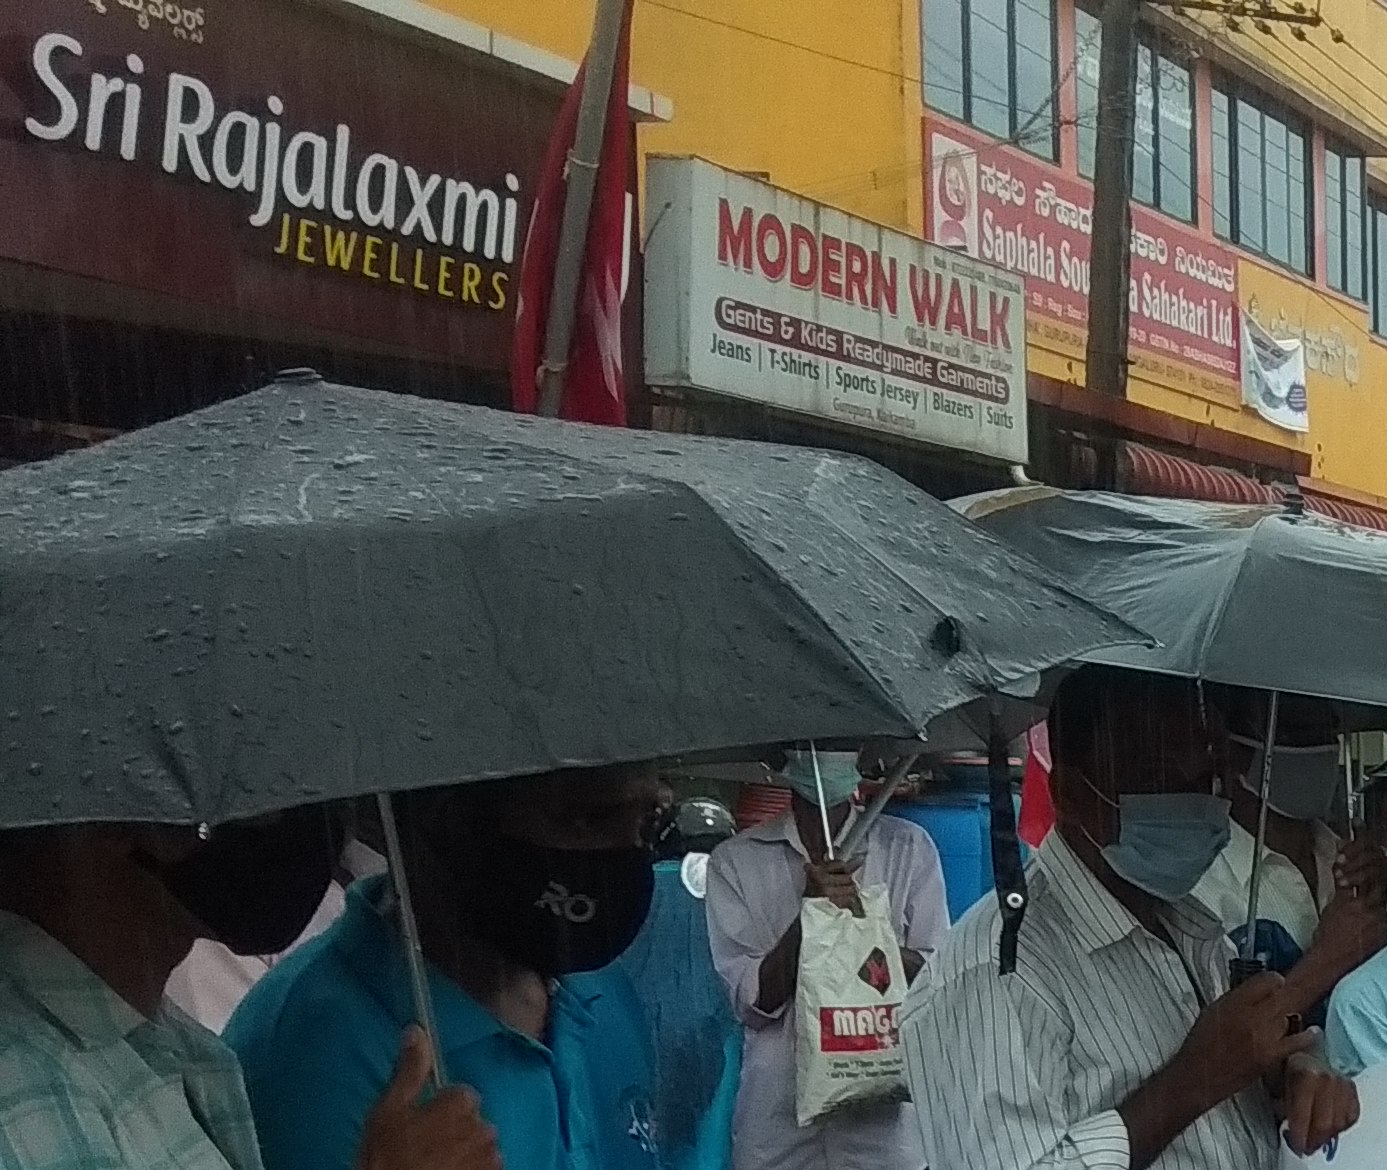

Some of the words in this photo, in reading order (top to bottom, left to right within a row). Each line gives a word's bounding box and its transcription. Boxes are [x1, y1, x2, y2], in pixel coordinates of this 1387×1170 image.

[25, 32, 144, 161] Sri
[161, 72, 519, 263] Rajalaxmi
[273, 212, 509, 311] JEWELLERS
[717, 195, 898, 319] MODERN
[908, 262, 1013, 353] WALK
[981, 207, 1056, 284] Saphala
[1142, 271, 1209, 339] Sahakari
[1211, 298, 1237, 349] Ltd.
[710, 332, 752, 364] Jeans
[768, 347, 820, 382] T-Shirts
[835, 366, 877, 396] Sports
[880, 377, 920, 411] Jersey
[933, 391, 974, 421] Blazers
[720, 299, 774, 336] Gents
[780, 315, 795, 341] &
[800, 322, 838, 353] Kids
[842, 333, 933, 380] Readymade
[937, 362, 1007, 400] Garments
